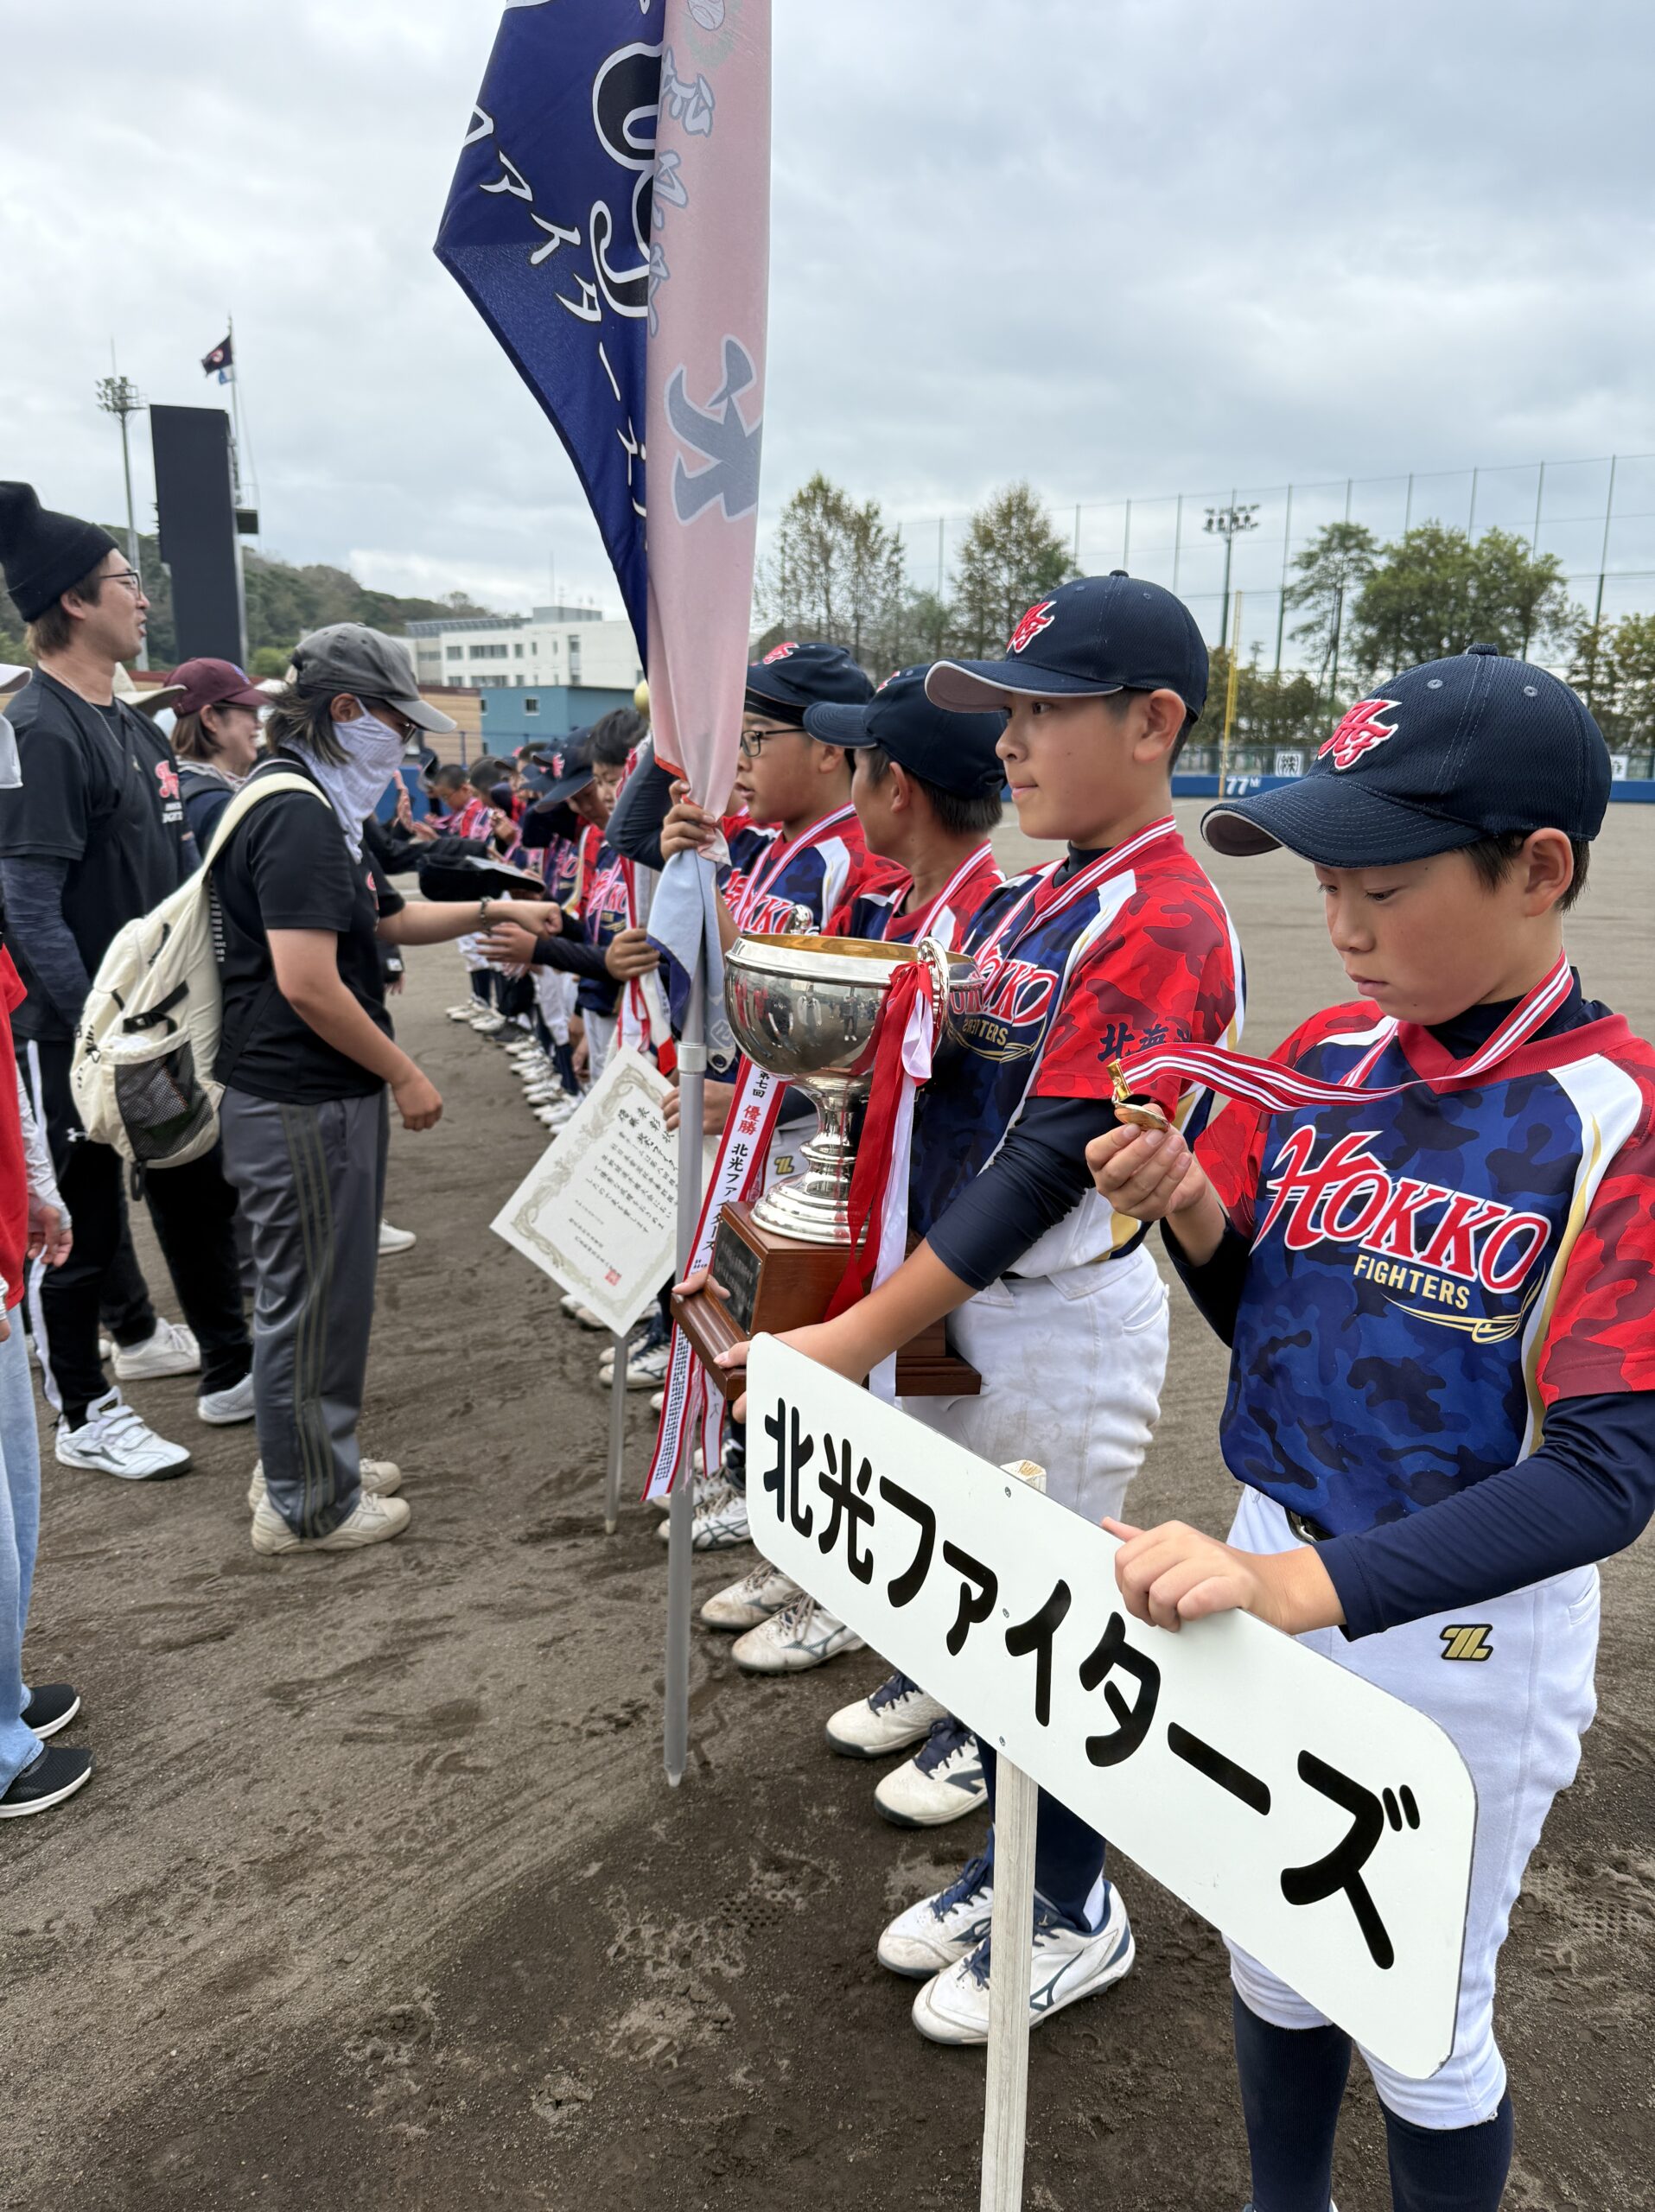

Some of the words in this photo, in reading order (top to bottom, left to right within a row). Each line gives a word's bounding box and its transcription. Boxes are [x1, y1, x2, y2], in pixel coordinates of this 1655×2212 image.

[637, 1107, 675, 1144] 表彰状
[737, 1104, 762, 1135] 優勝
[1248, 1123, 1553, 1295] HOKKO
[1352, 1253, 1471, 1311] FIGHTERS
[764, 1396, 1422, 1971] 北光ファイターズ
